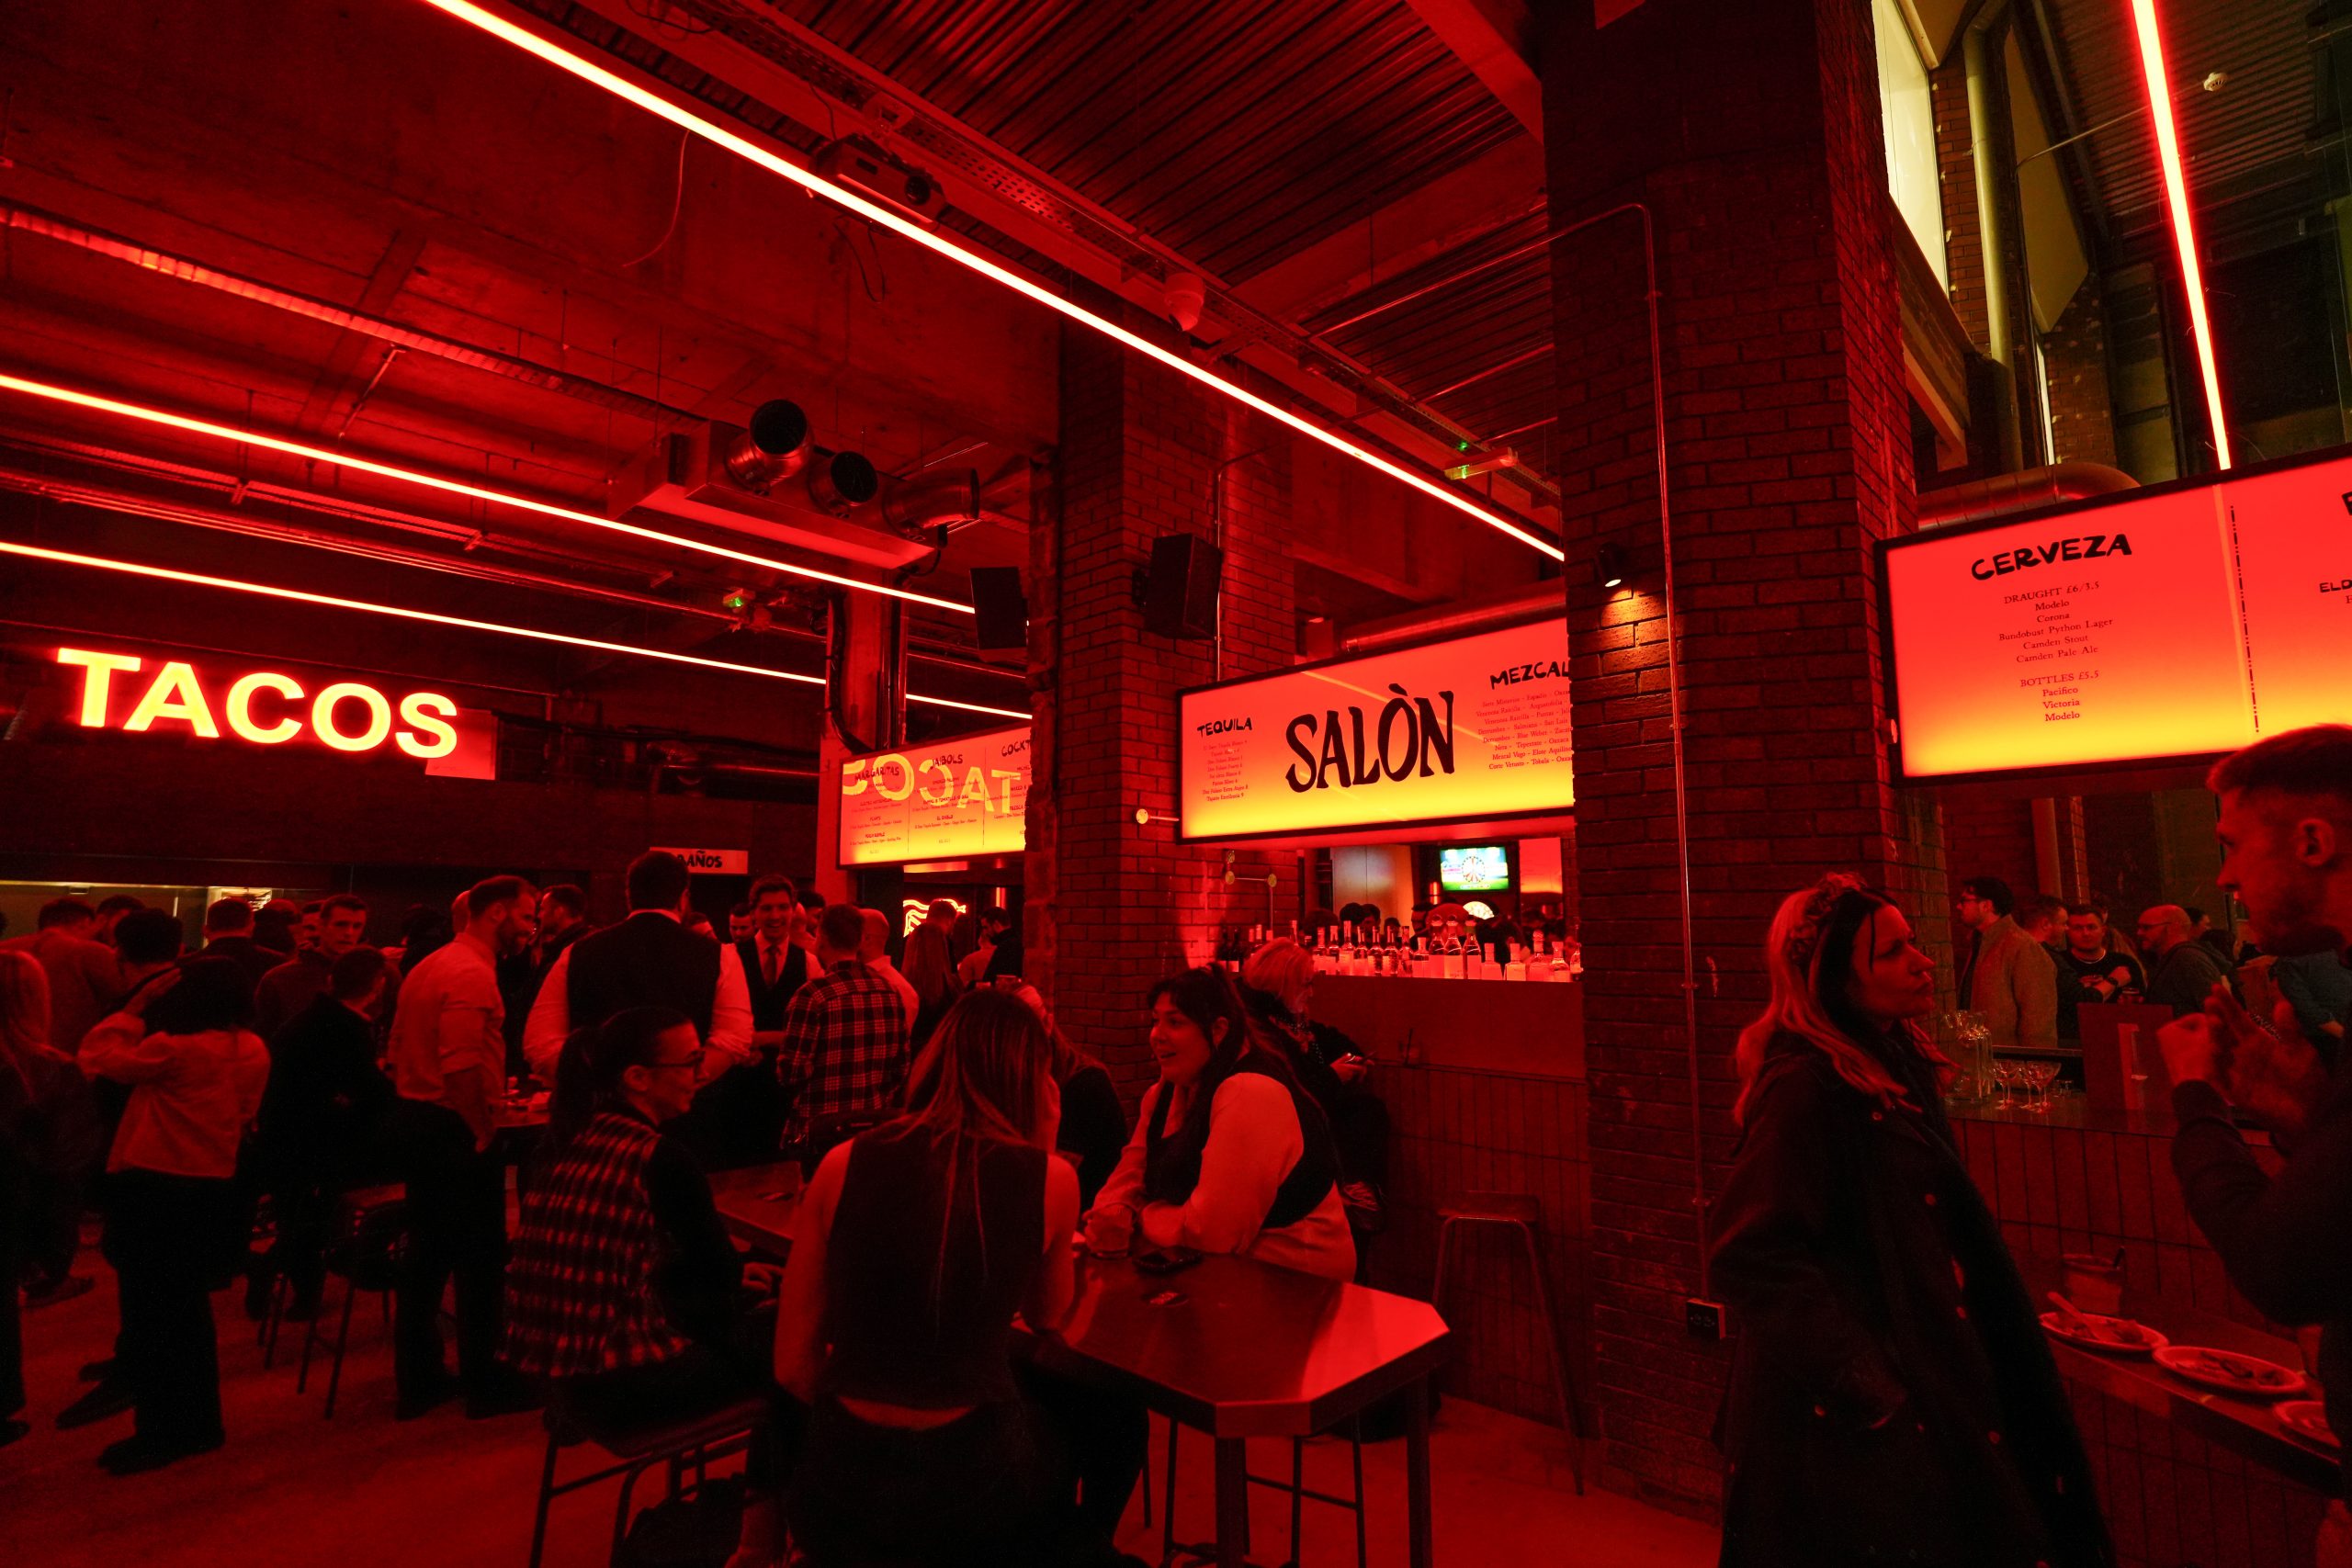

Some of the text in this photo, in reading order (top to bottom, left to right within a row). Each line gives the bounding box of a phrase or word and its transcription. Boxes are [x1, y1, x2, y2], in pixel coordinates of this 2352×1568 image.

[1972, 534, 2132, 581] CERVEZA
[2004, 581, 2100, 604] DRAUGHT £6/3.5
[2035, 599, 2070, 611] Modelo
[2037, 613, 2070, 623] Corona
[1998, 617, 2114, 641] Bundobust Python Lager
[2023, 635, 2088, 649] Camden Stout
[2016, 645, 2099, 663] Camden Pale Ale
[1490, 661, 1569, 690] MEZCAL
[2020, 670, 2100, 687] BOTTLES £5.5
[2042, 686, 2079, 697] Pacifico
[57, 648, 458, 760] TACOS
[2043, 698, 2081, 709] Victoria
[2045, 711, 2081, 722] Modelo
[1196, 717, 1253, 738] TEQUILA
[1285, 682, 1455, 793] SALÒN
[855, 766, 899, 782] MARGARITAS
